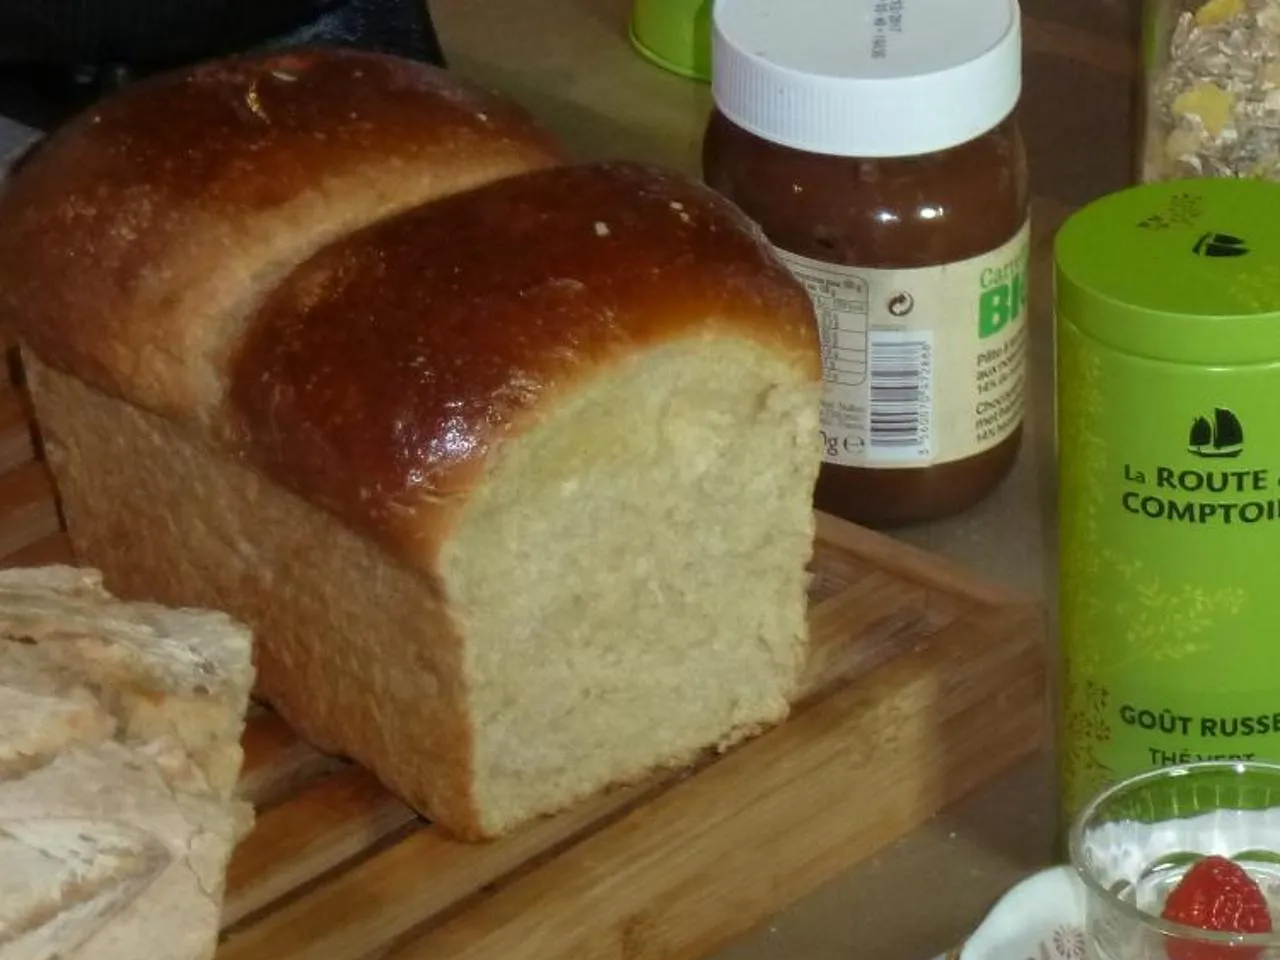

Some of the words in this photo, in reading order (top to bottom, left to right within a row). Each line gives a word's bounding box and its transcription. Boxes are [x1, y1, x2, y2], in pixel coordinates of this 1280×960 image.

[1123, 463, 1146, 485] La
[1156, 465, 1268, 493] ROUTE
[1119, 704, 1193, 736] GOÛT
